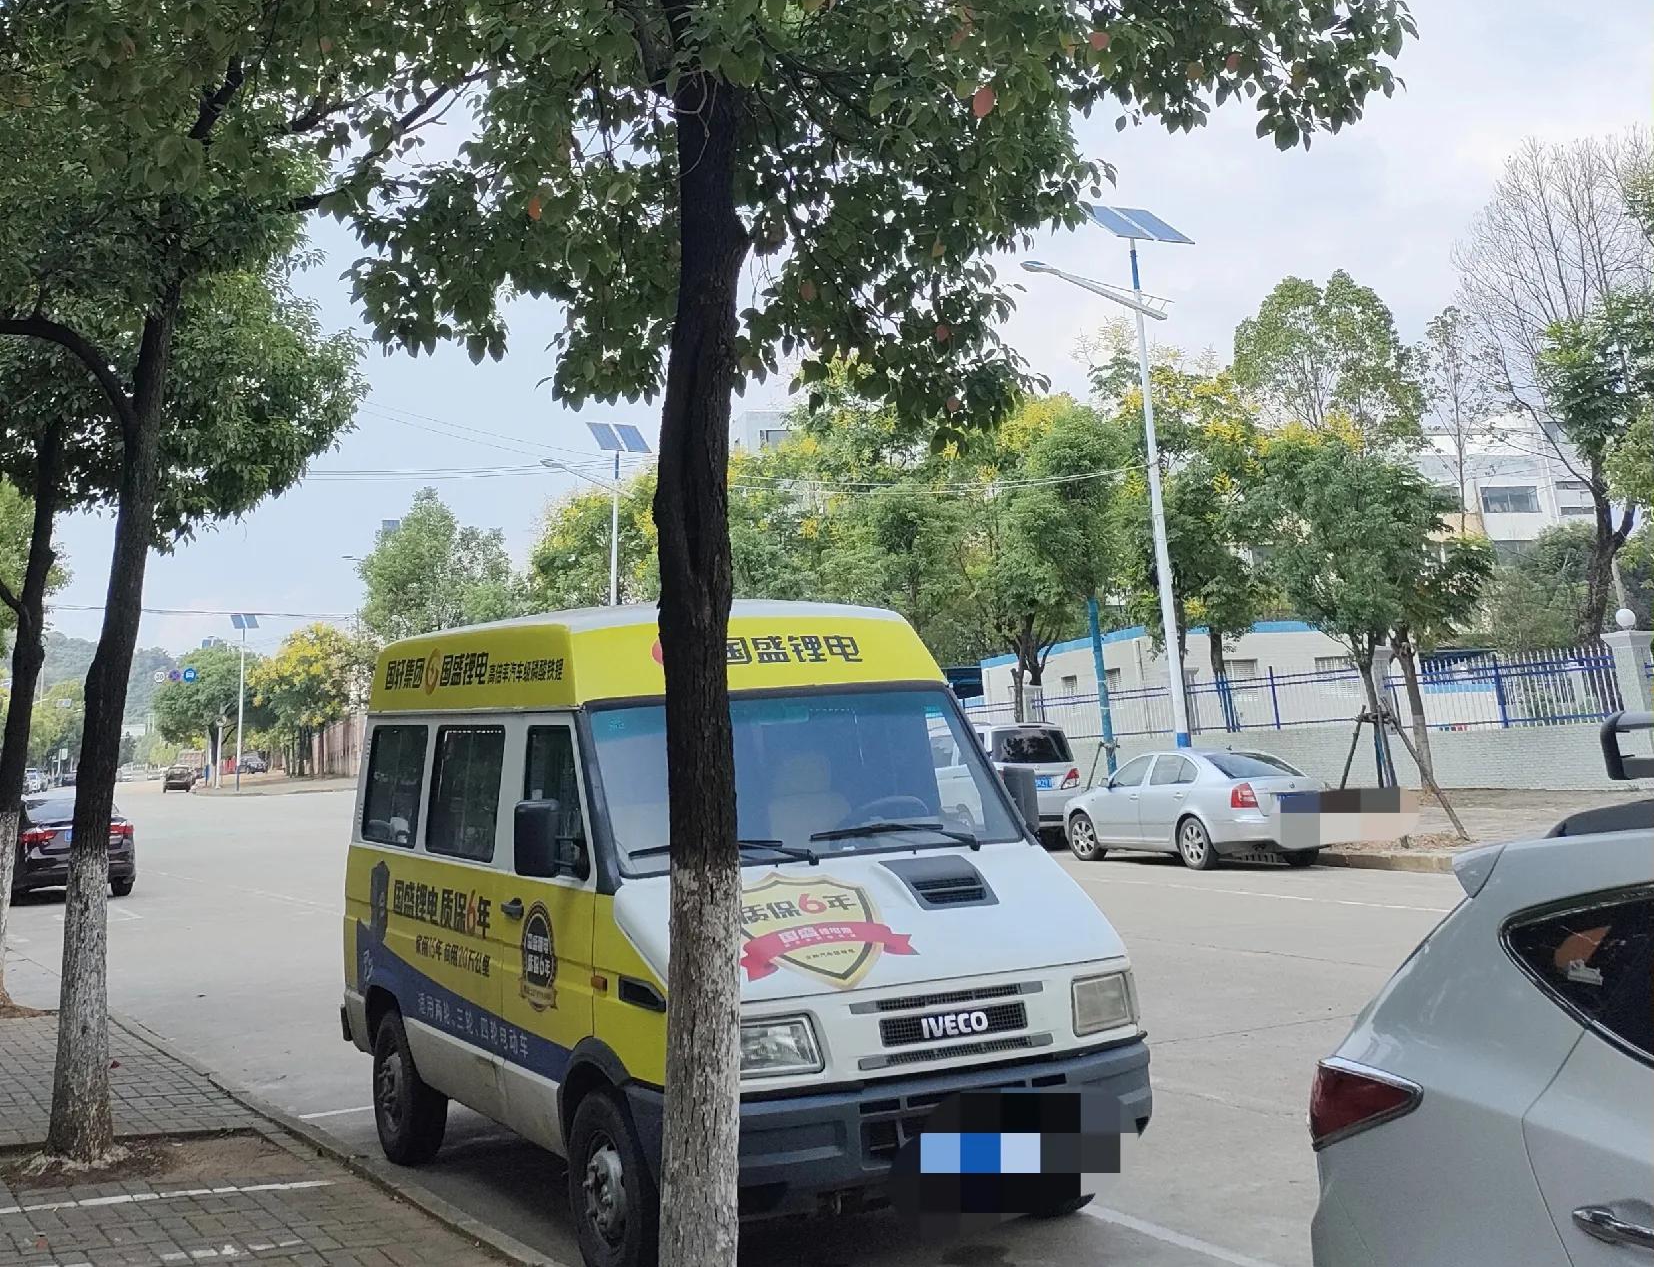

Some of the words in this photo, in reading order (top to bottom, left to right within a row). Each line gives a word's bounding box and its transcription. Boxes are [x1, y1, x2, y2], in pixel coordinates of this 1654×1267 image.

[726, 635, 863, 664] 国盛锂电
[440, 652, 489, 687] 国盛锂电
[741, 893, 856, 925] 质保6年
[921, 1011, 989, 1039] IVECO
